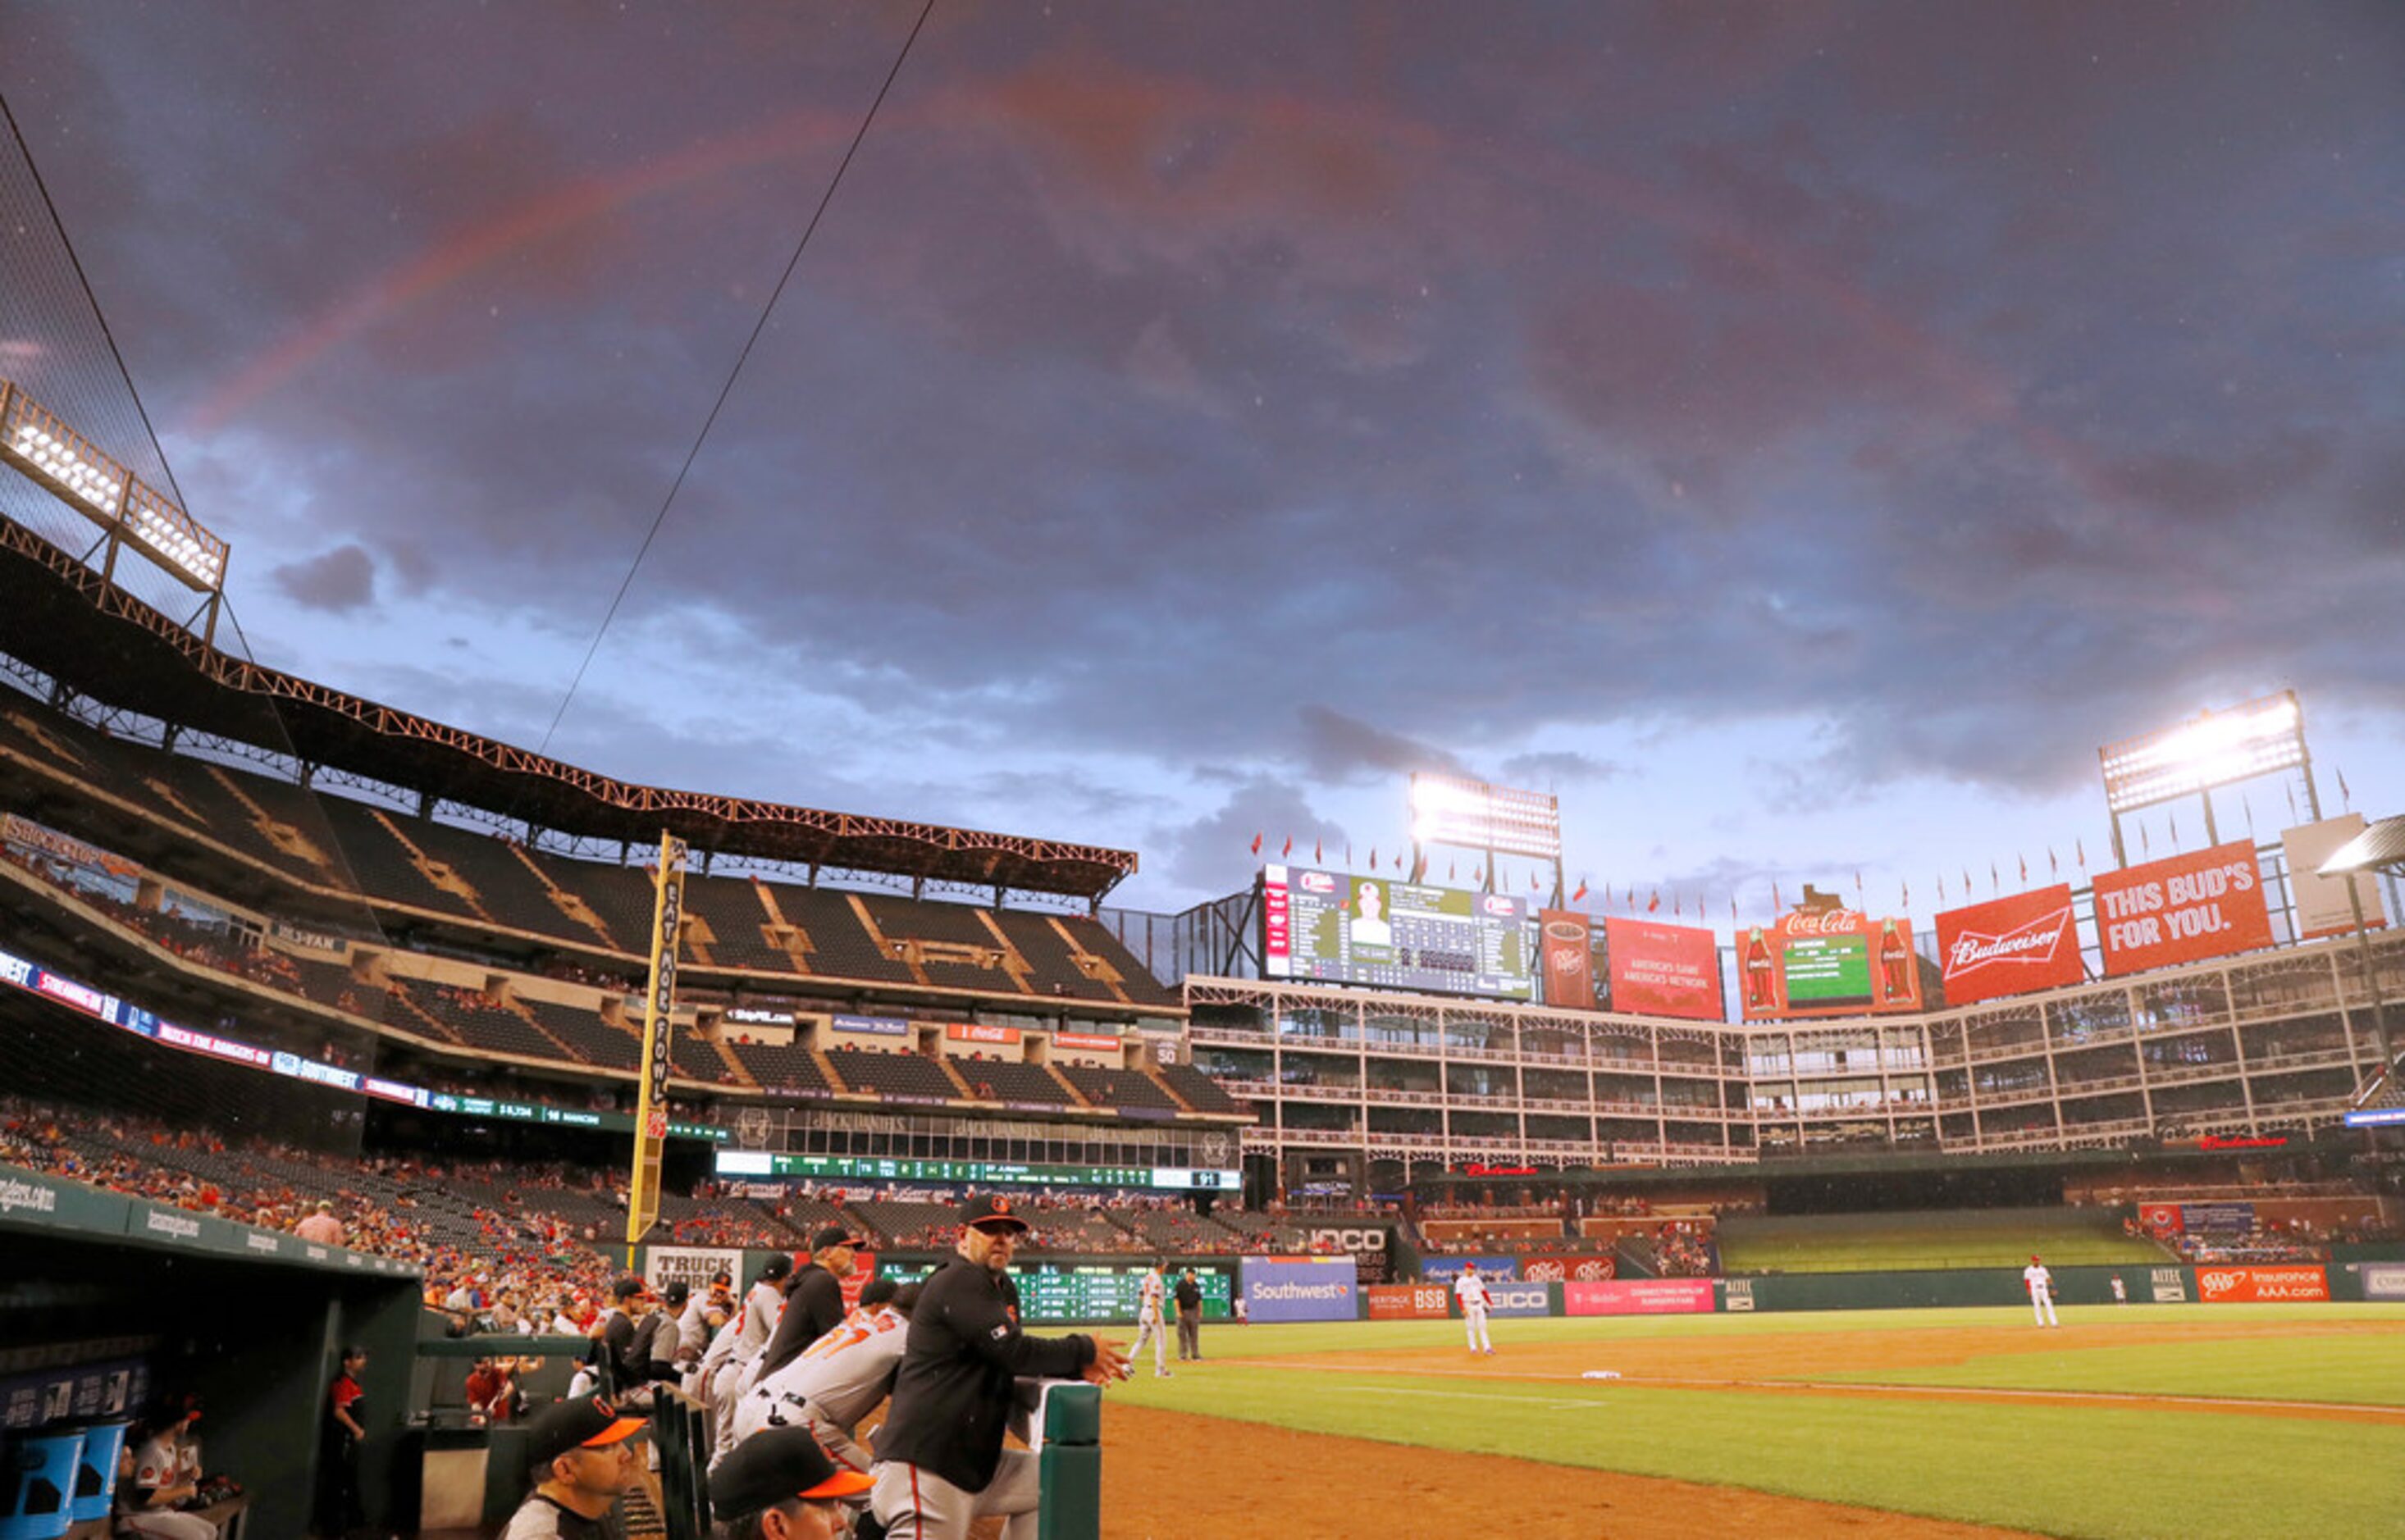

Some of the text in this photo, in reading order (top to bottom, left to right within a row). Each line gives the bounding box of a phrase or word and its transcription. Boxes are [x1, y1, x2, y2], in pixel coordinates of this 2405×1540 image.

[2102, 862, 2253, 918] THIS BUD'S
[663, 885, 677, 940] EAT
[2108, 903, 2232, 951] FOR YOU.
[1951, 930, 2060, 965] Budweiser
[1631, 958, 1674, 972] AMERICA'S
[659, 952, 673, 1010] MOR
[1624, 971, 1708, 988] AMERICA'S NETWORK
[653, 1021, 669, 1101] FOWL
[657, 1255, 733, 1273] TRUCK
[2252, 1271, 2321, 1283] Insurance
[1253, 1281, 1337, 1300] Southwest
[1369, 1295, 1410, 1305] HERITAGE
[1415, 1290, 1446, 1309] BSB
[1490, 1291, 1547, 1309] EICO
[2257, 1285, 2324, 1297] AAA.com
